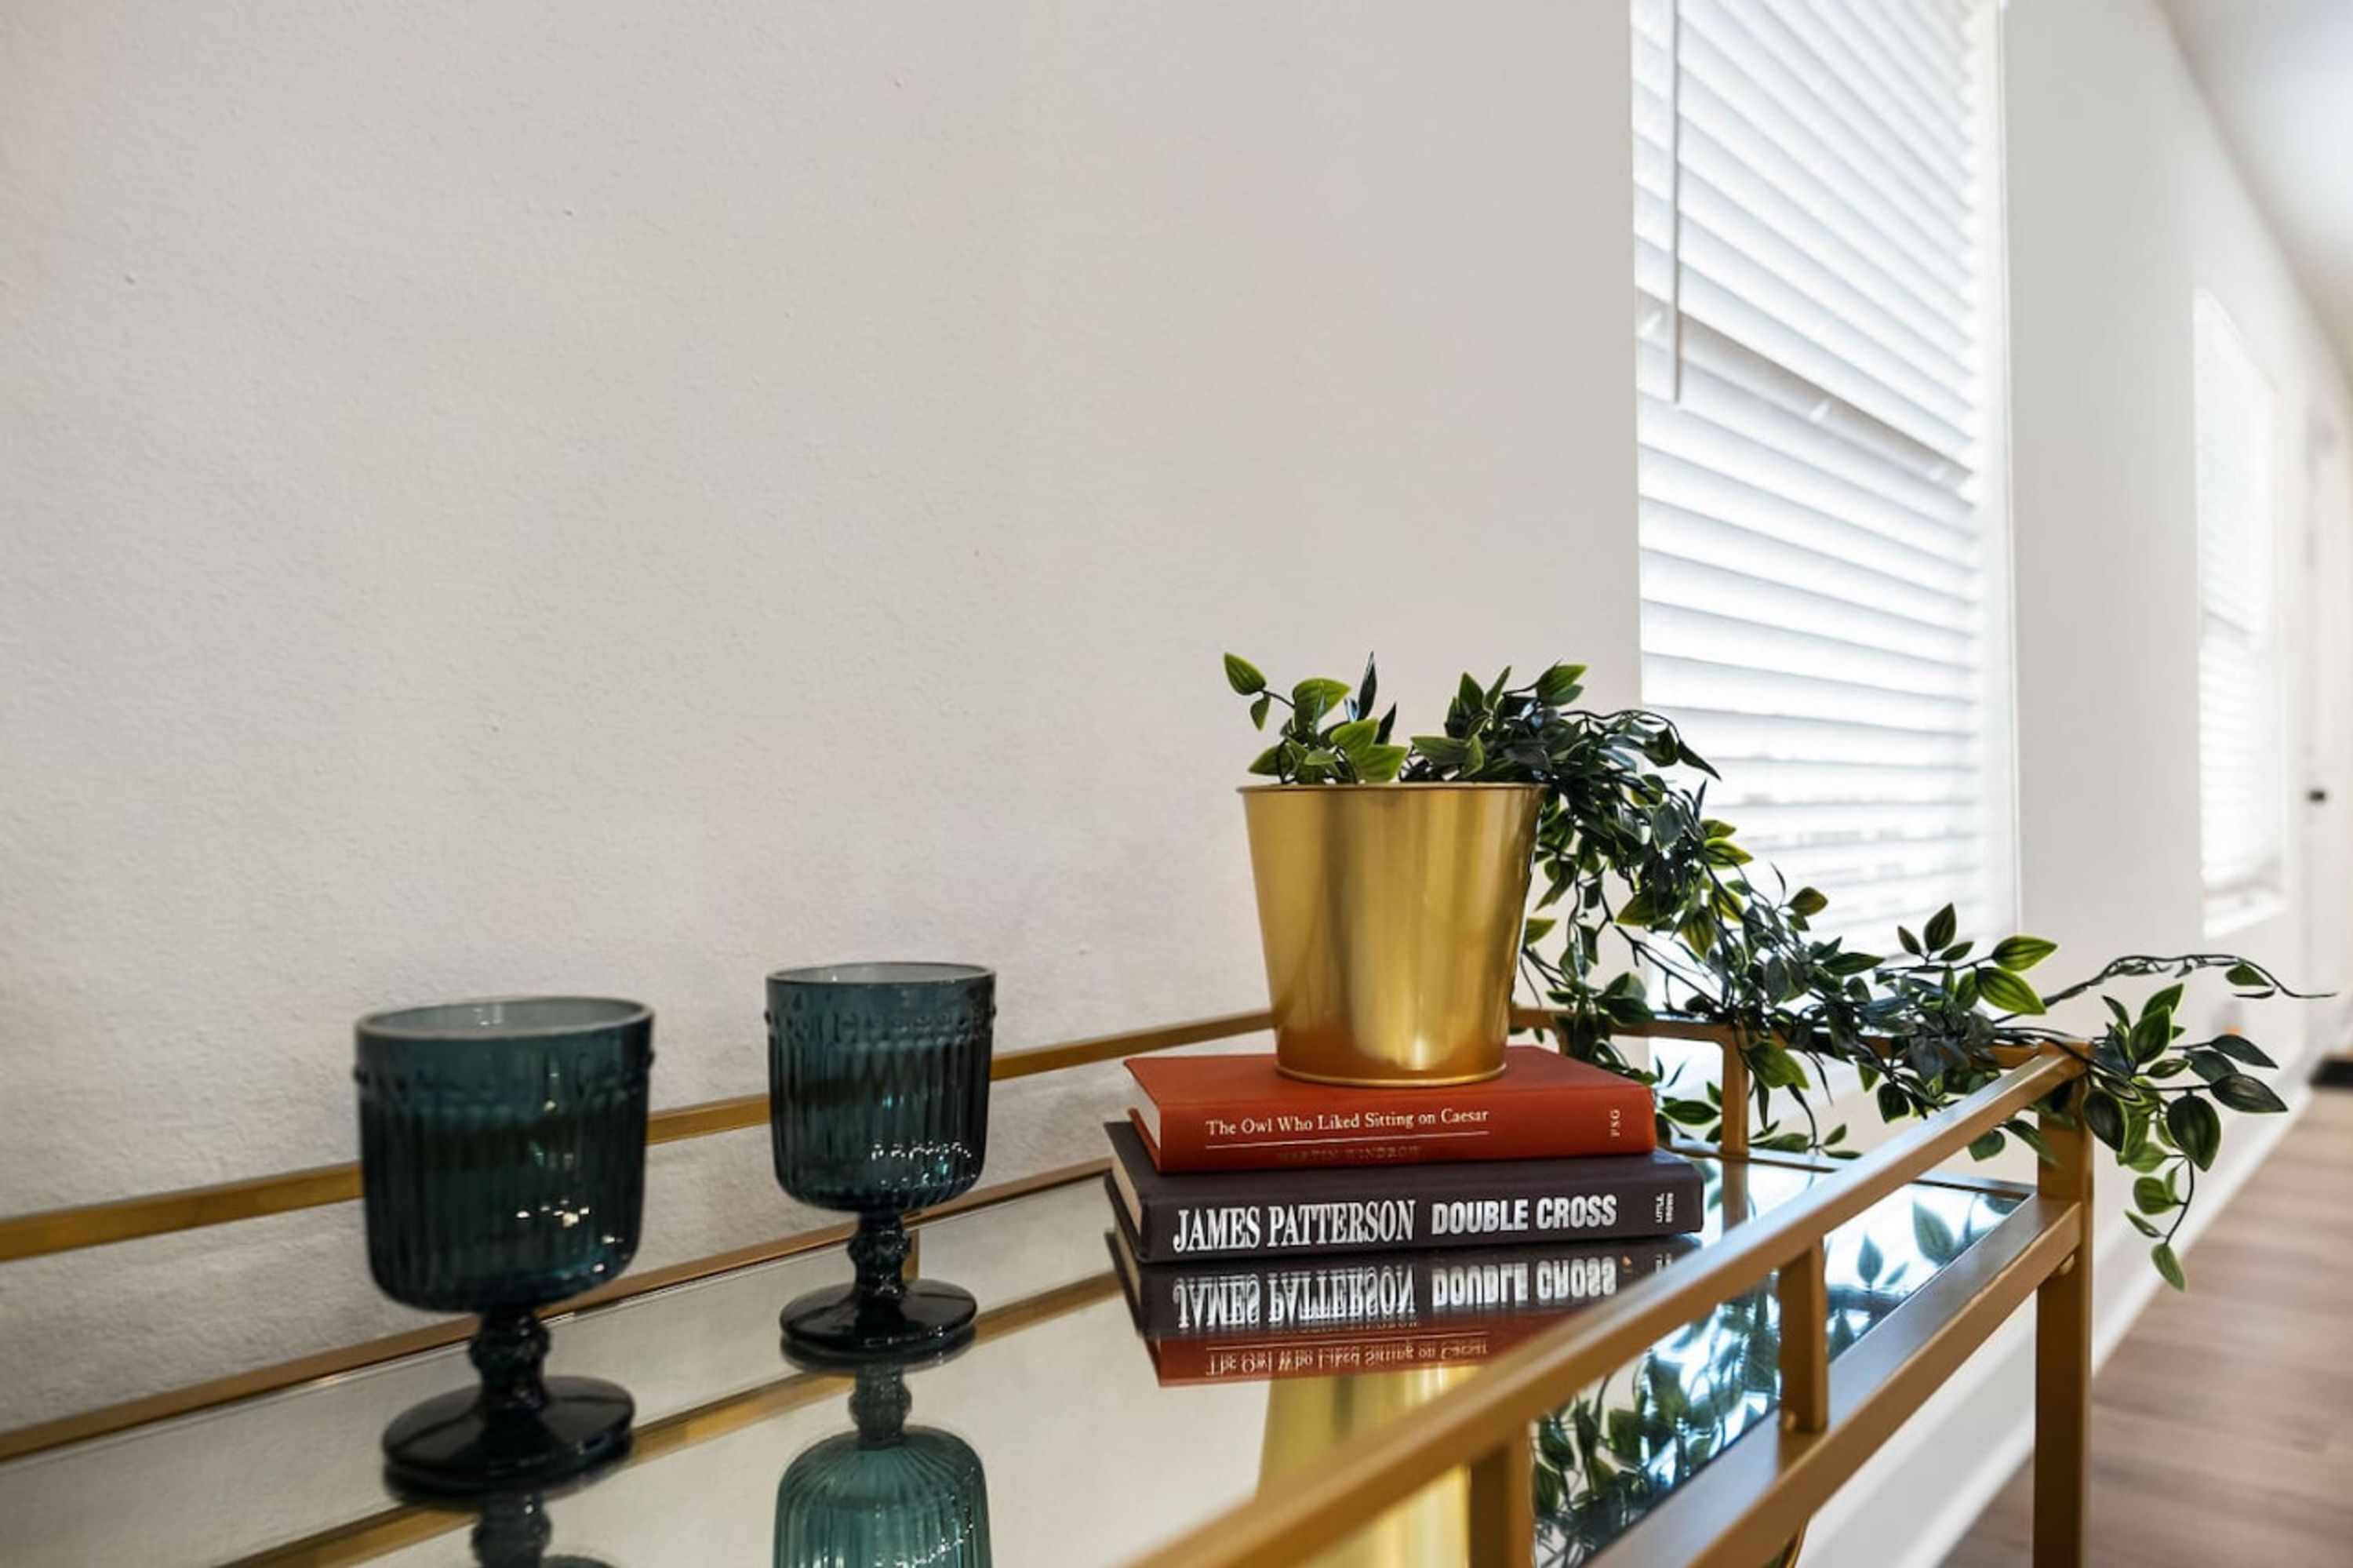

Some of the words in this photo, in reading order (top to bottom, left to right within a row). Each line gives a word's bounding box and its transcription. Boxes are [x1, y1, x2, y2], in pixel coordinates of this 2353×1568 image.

[1206, 1119, 1237, 1136] The
[1241, 1117, 1273, 1134] Owl
[1278, 1115, 1313, 1132] Who
[1318, 1112, 1360, 1130] Liked
[1365, 1111, 1414, 1130] Sitting
[1418, 1112, 1436, 1125] on
[1441, 1107, 1489, 1124] Caesar
[1173, 1205, 1261, 1253] JAMES
[1267, 1199, 1417, 1248] PATTERSON
[1431, 1199, 1529, 1235] DOUBLE
[1537, 1194, 1617, 1230] CROSS
